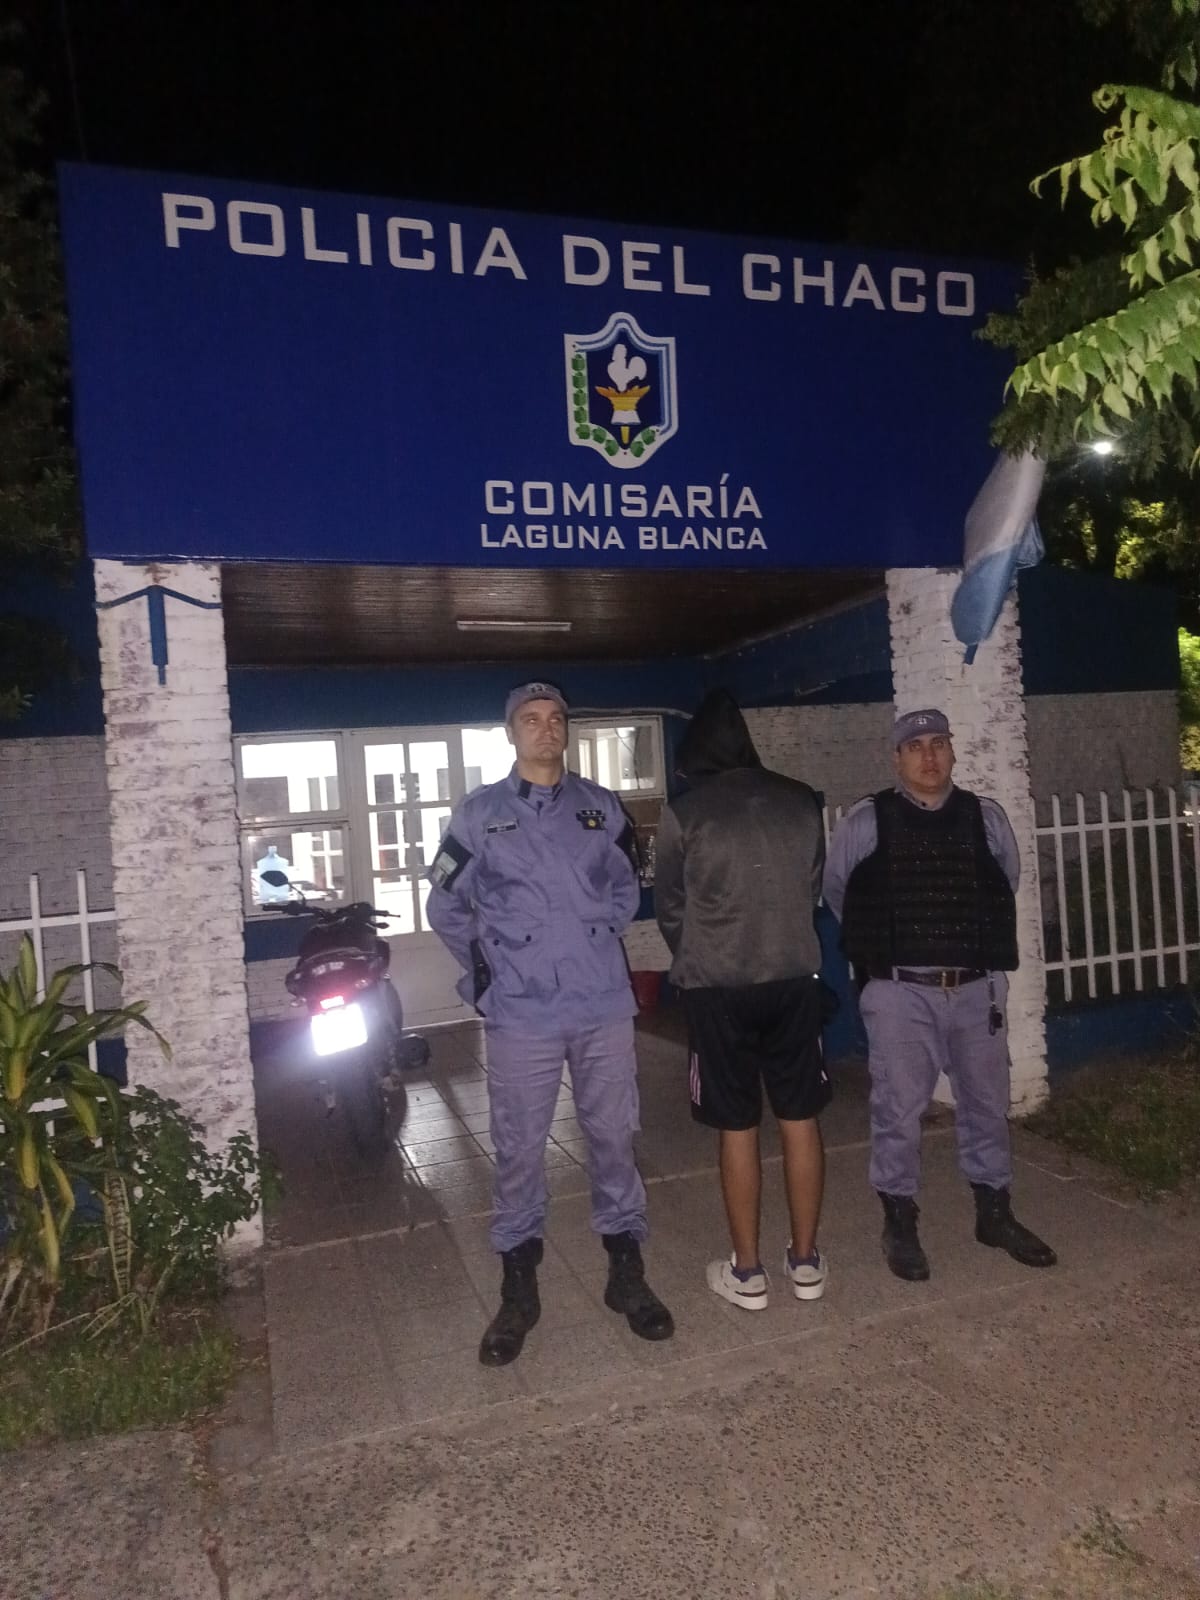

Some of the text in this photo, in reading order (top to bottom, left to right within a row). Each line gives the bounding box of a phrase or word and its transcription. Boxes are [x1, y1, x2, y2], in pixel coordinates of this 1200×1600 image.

[162, 192, 975, 317] POLICIA DEL CHACO
[485, 473, 763, 519] COMISARÍA
[480, 523, 768, 550] LAGUNA BLANCA
